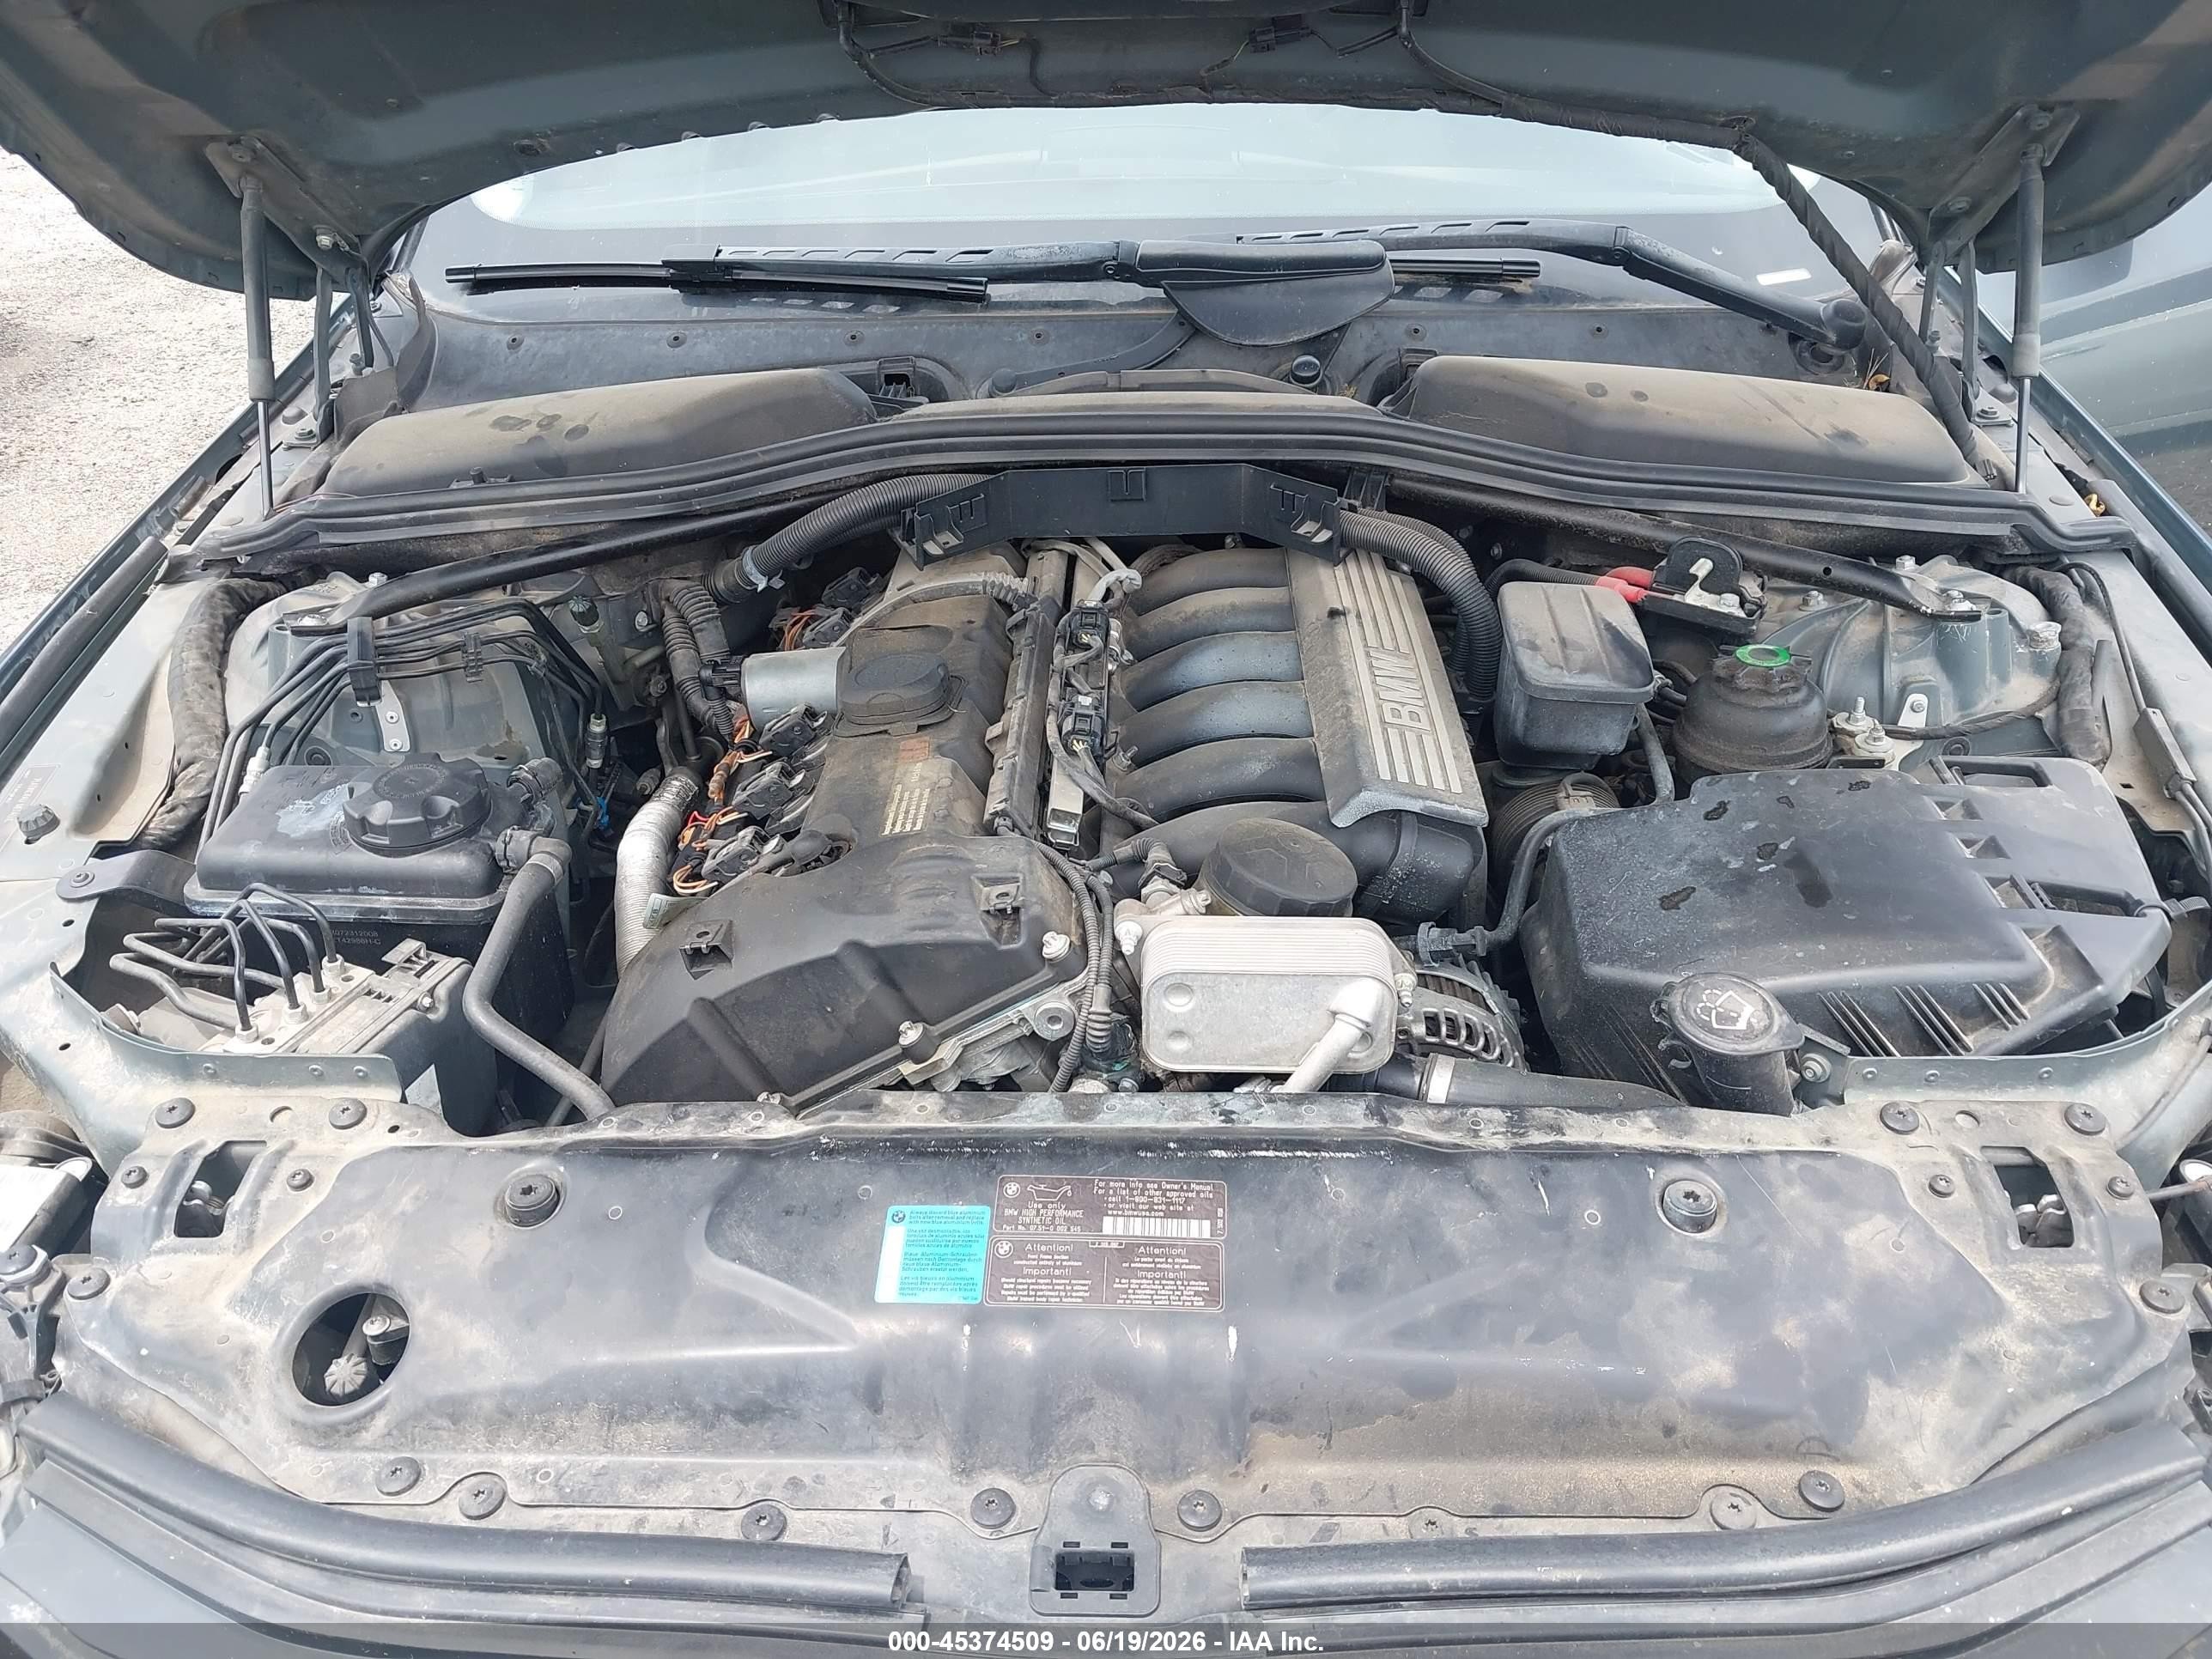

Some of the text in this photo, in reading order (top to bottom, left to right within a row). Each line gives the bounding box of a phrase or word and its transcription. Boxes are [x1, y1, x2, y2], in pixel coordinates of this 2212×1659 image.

[1368, 650, 1431, 732] BMW
[1095, 1179, 1105, 1188] For
[1162, 1181, 1187, 1190] Owner's
[1190, 1182, 1213, 1191] Manual
[1145, 1188, 1163, 1197] other
[1166, 1190, 1196, 1199] approved
[1028, 1200, 1066, 1211] Use only
[1004, 1208, 1085, 1218] BMW HIGH PERFORMANCE
[1018, 1216, 1066, 1225] SYNTHETIC OIL
[1024, 1243, 1073, 1252] Attention!
[1138, 1245, 1187, 1255] Attention!
[1023, 1267, 1072, 1278] Important!
[1137, 1270, 1187, 1280] Important!
